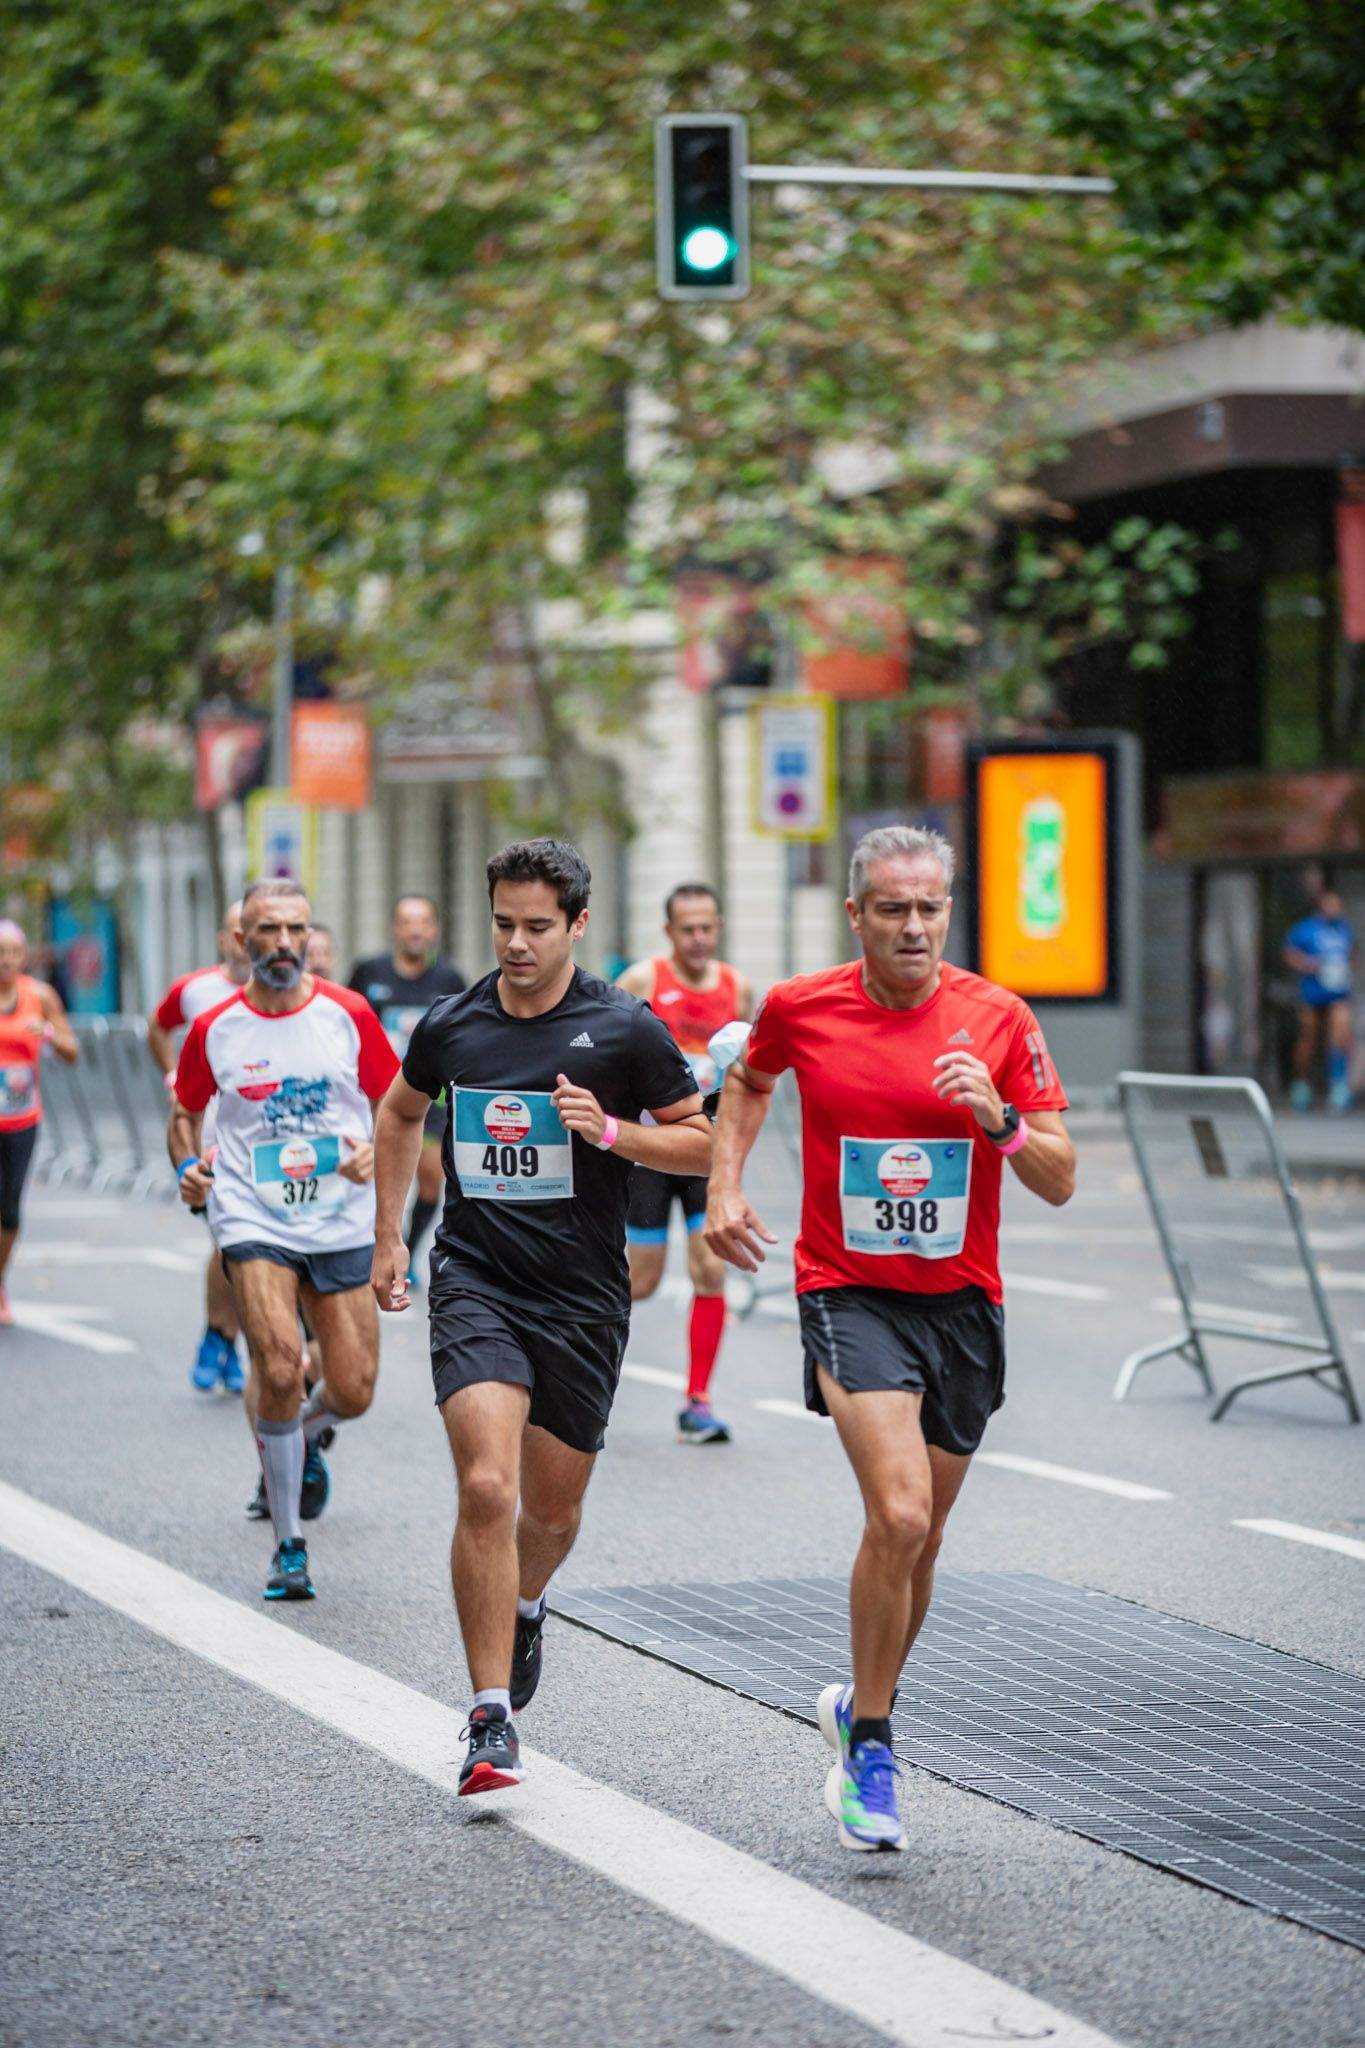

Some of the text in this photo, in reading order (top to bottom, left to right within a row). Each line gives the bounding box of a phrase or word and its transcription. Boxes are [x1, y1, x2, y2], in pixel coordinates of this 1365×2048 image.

[569, 1039, 594, 1048] adidas
[482, 1145, 539, 1178] 409
[283, 1178, 318, 1205] 372
[875, 1199, 938, 1234] 398
